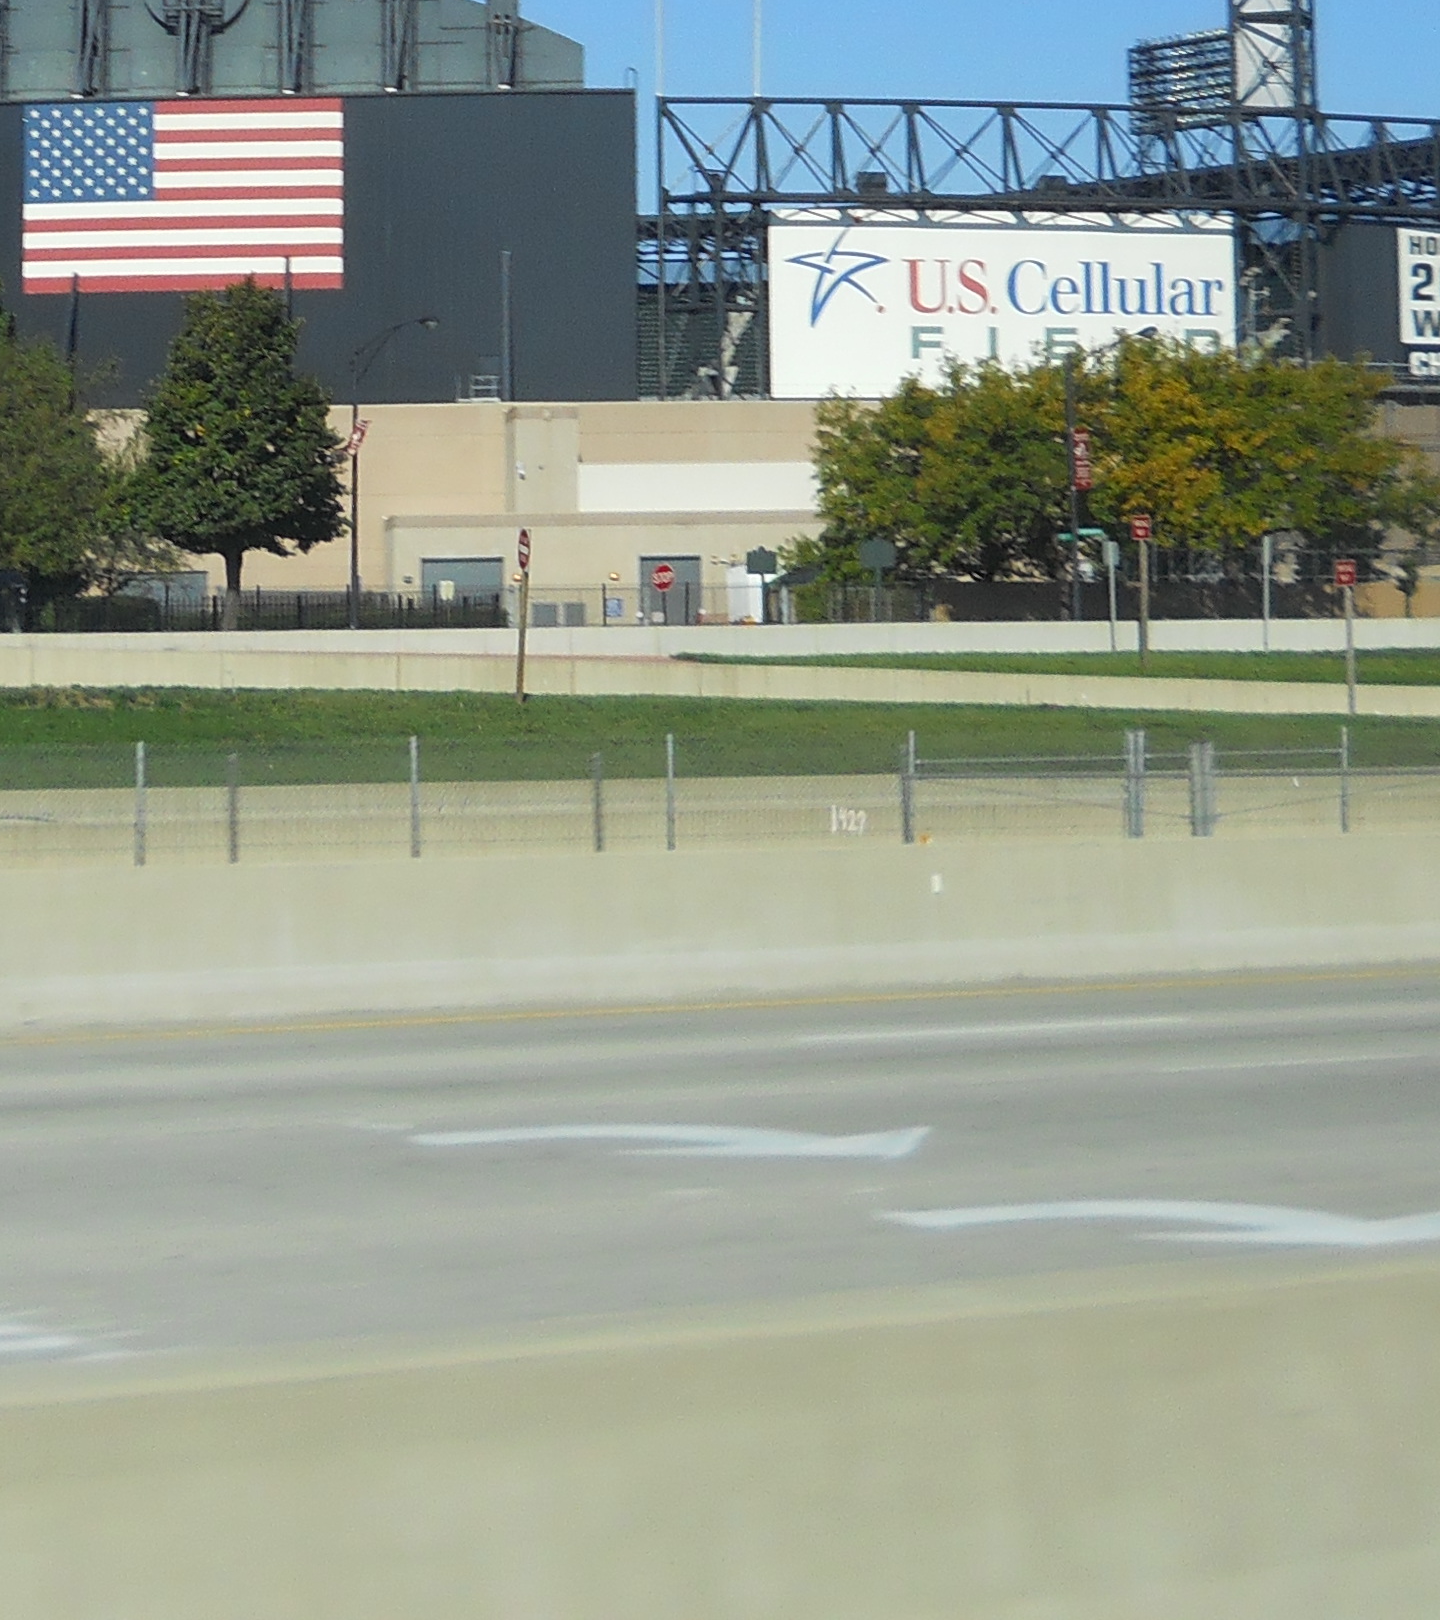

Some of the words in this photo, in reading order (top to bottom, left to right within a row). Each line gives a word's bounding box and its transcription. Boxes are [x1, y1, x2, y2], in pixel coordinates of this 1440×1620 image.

[902, 258, 998, 315] U.S.
[1006, 259, 1224, 316] Cellular
[911, 326, 1221, 361] FIED
